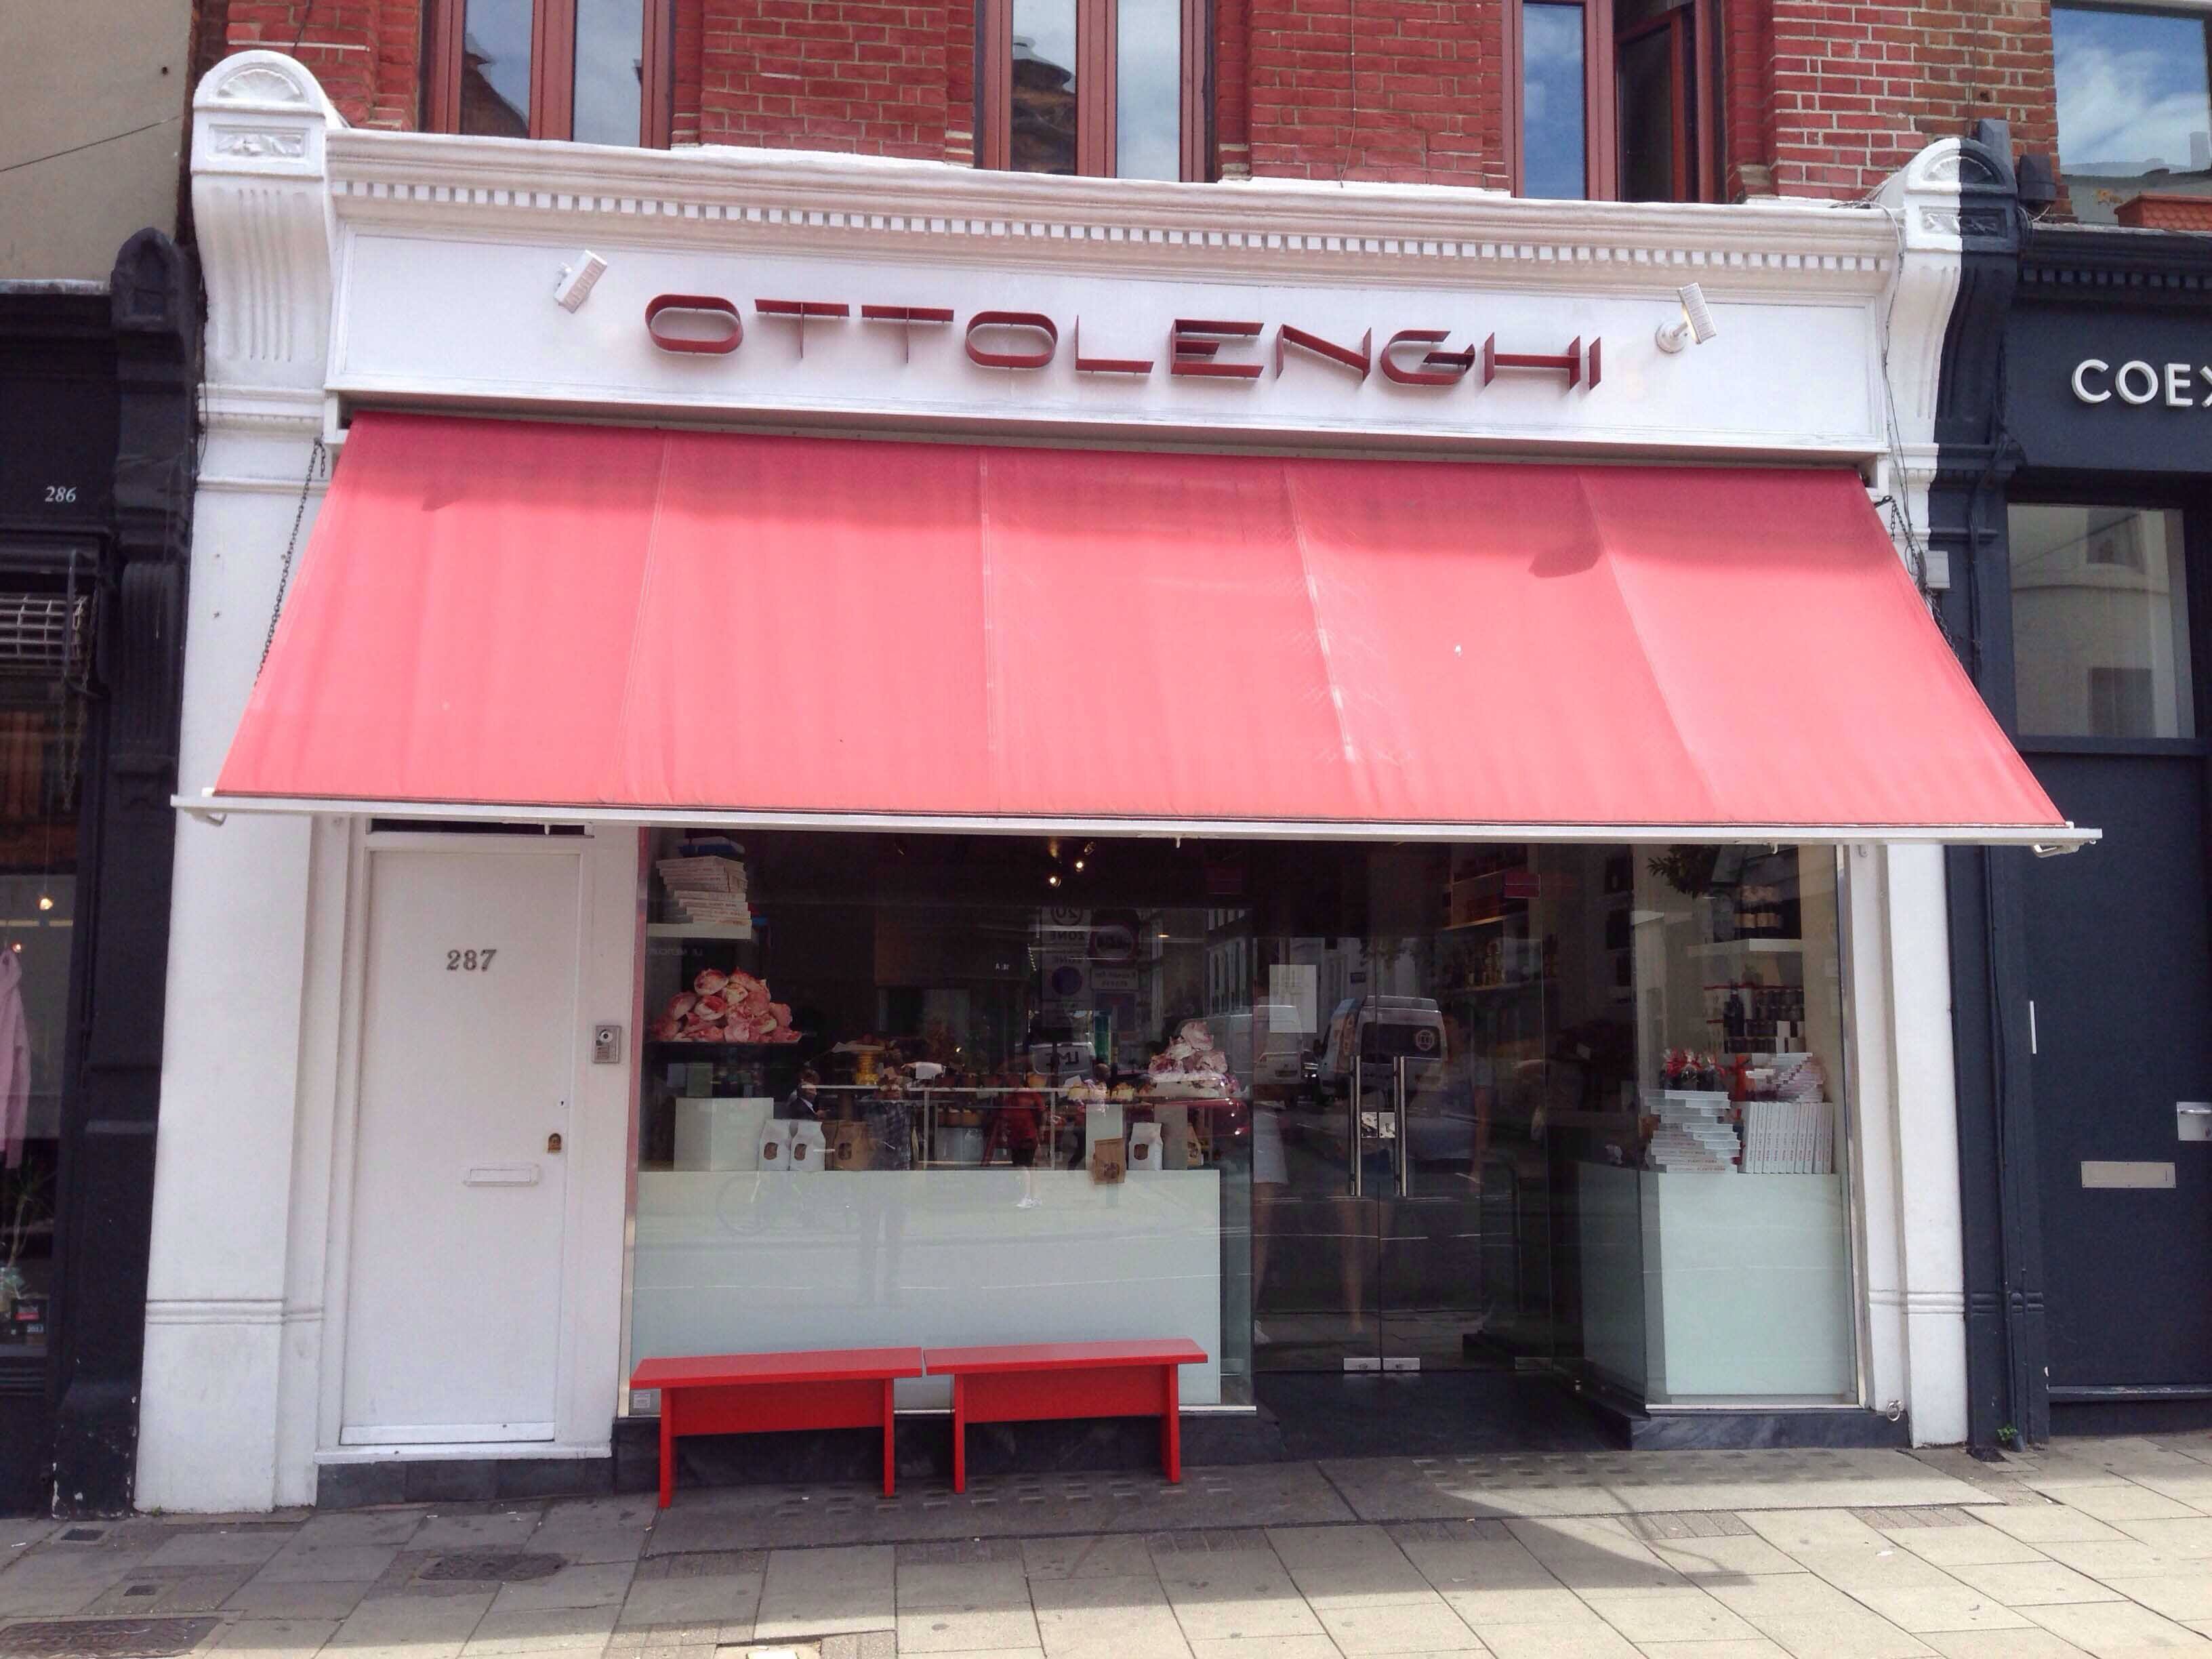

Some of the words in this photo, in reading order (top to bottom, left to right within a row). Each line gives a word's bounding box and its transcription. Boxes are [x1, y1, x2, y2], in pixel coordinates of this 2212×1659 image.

[645, 293, 1601, 391] OTTOLENGHI
[45, 486, 77, 503] 286
[446, 949, 497, 972] 287
